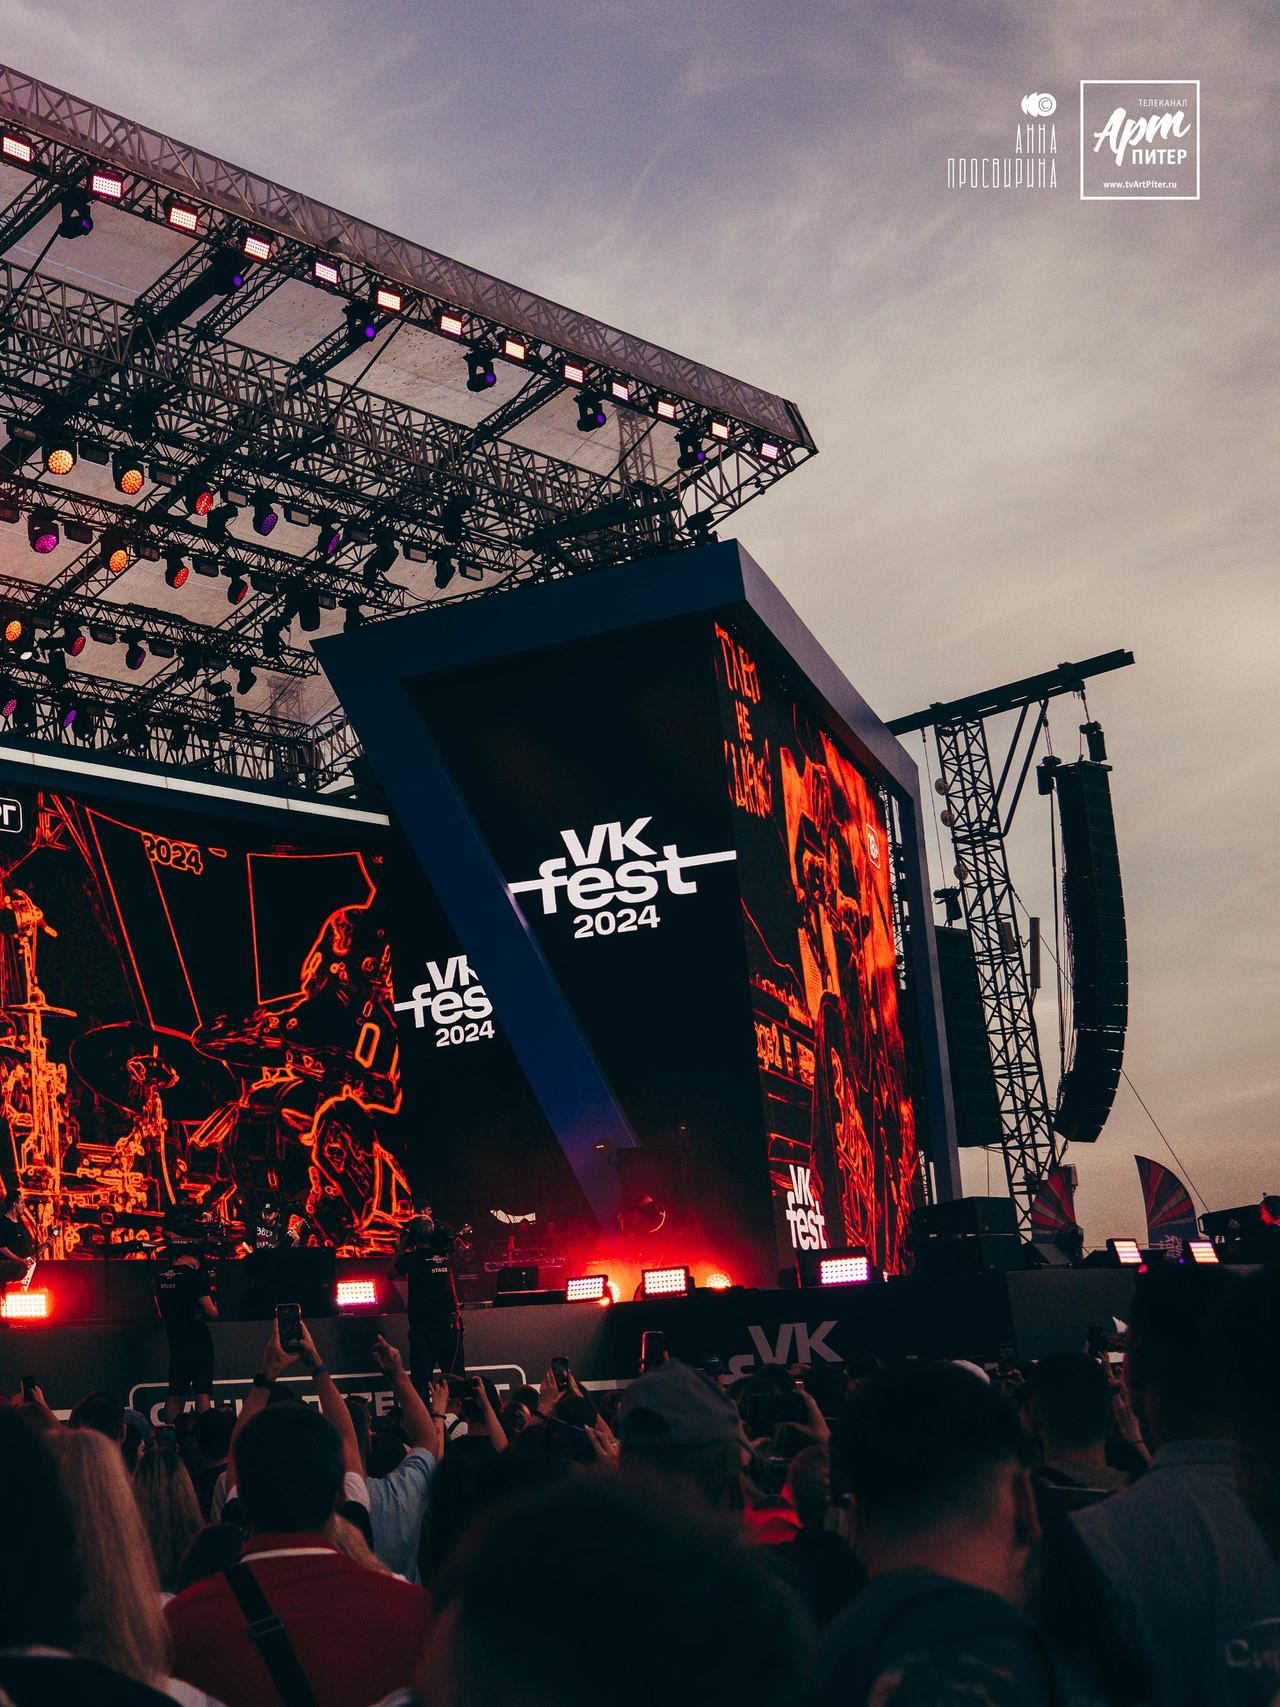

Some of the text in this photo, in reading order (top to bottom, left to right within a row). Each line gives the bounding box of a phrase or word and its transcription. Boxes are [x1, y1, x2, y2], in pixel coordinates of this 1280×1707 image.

[560, 816, 658, 867] VK
[508, 844, 737, 915] fest
[573, 905, 661, 939] 2024
[394, 983, 494, 1028] fes
[435, 1020, 495, 1047] 2024
[789, 1164, 815, 1207] VK
[785, 1190, 827, 1250] fest
[748, 1320, 844, 1364] VK
